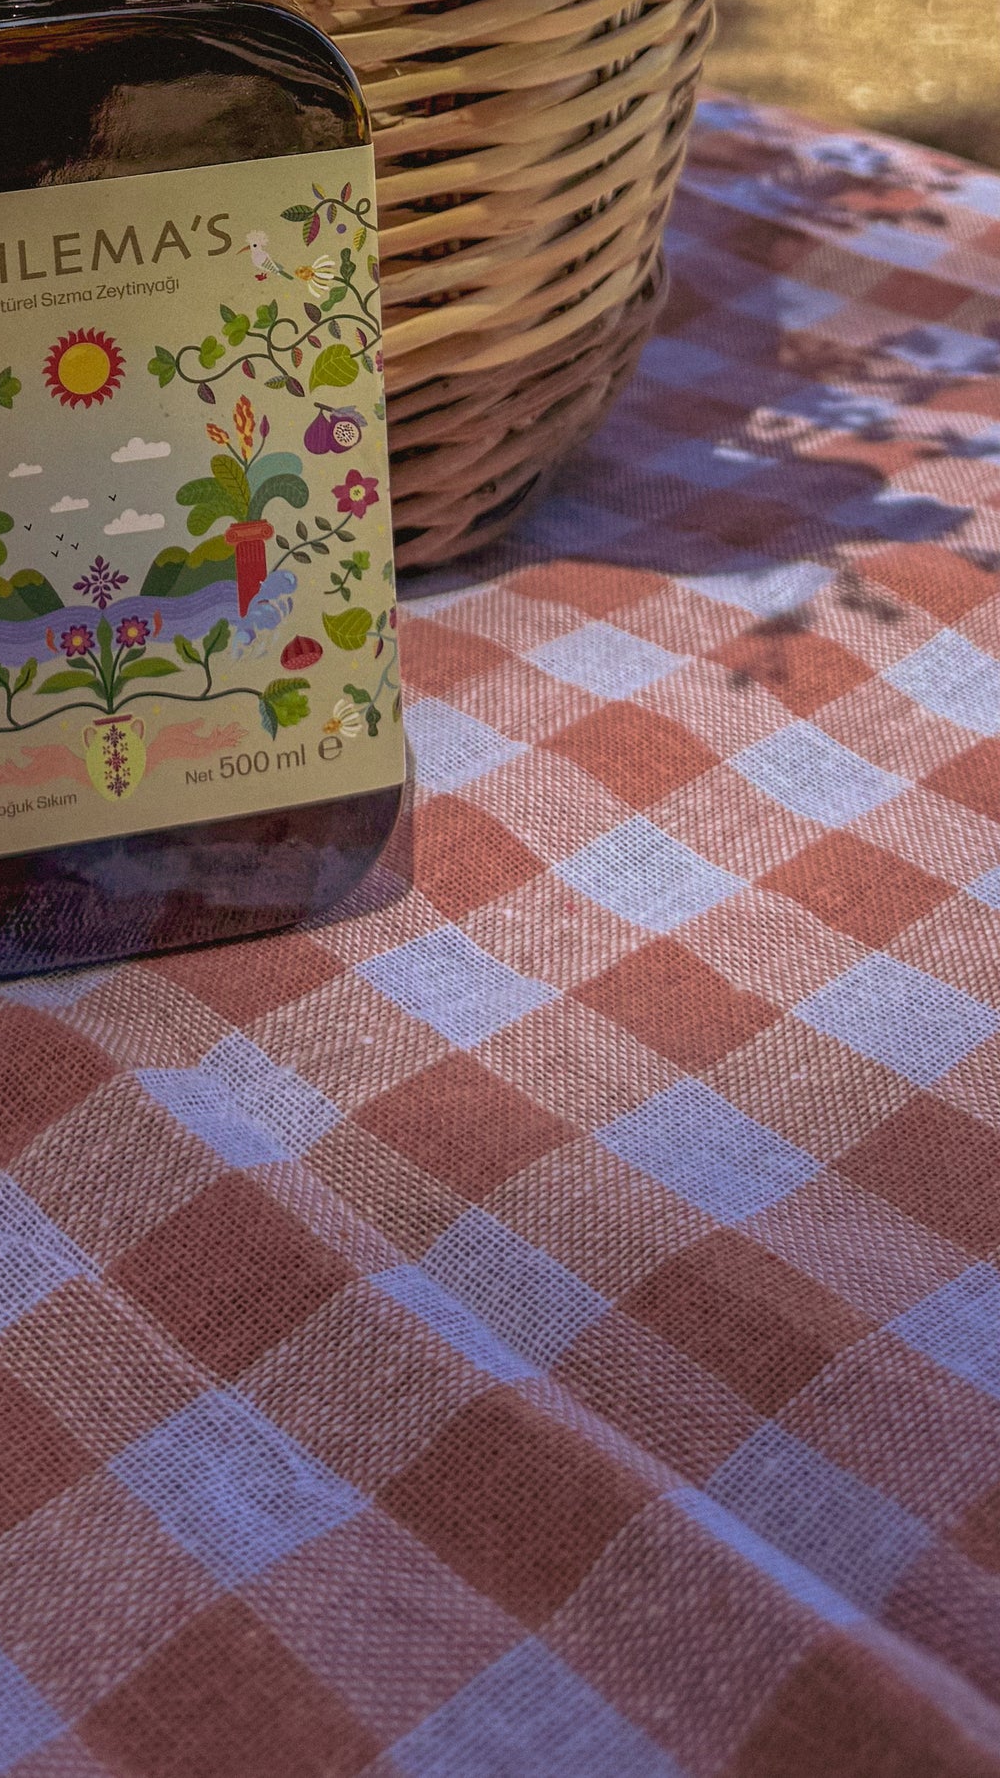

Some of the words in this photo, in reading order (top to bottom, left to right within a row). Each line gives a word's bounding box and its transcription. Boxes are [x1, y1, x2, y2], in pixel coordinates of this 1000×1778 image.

[40, 289, 93, 308] Sızma
[95, 275, 181, 301] Zeytinyağı
[185, 768, 214, 785] Net
[219, 750, 270, 780] 500
[276, 743, 307, 770] ml
[36, 793, 78, 810] Sıkım
